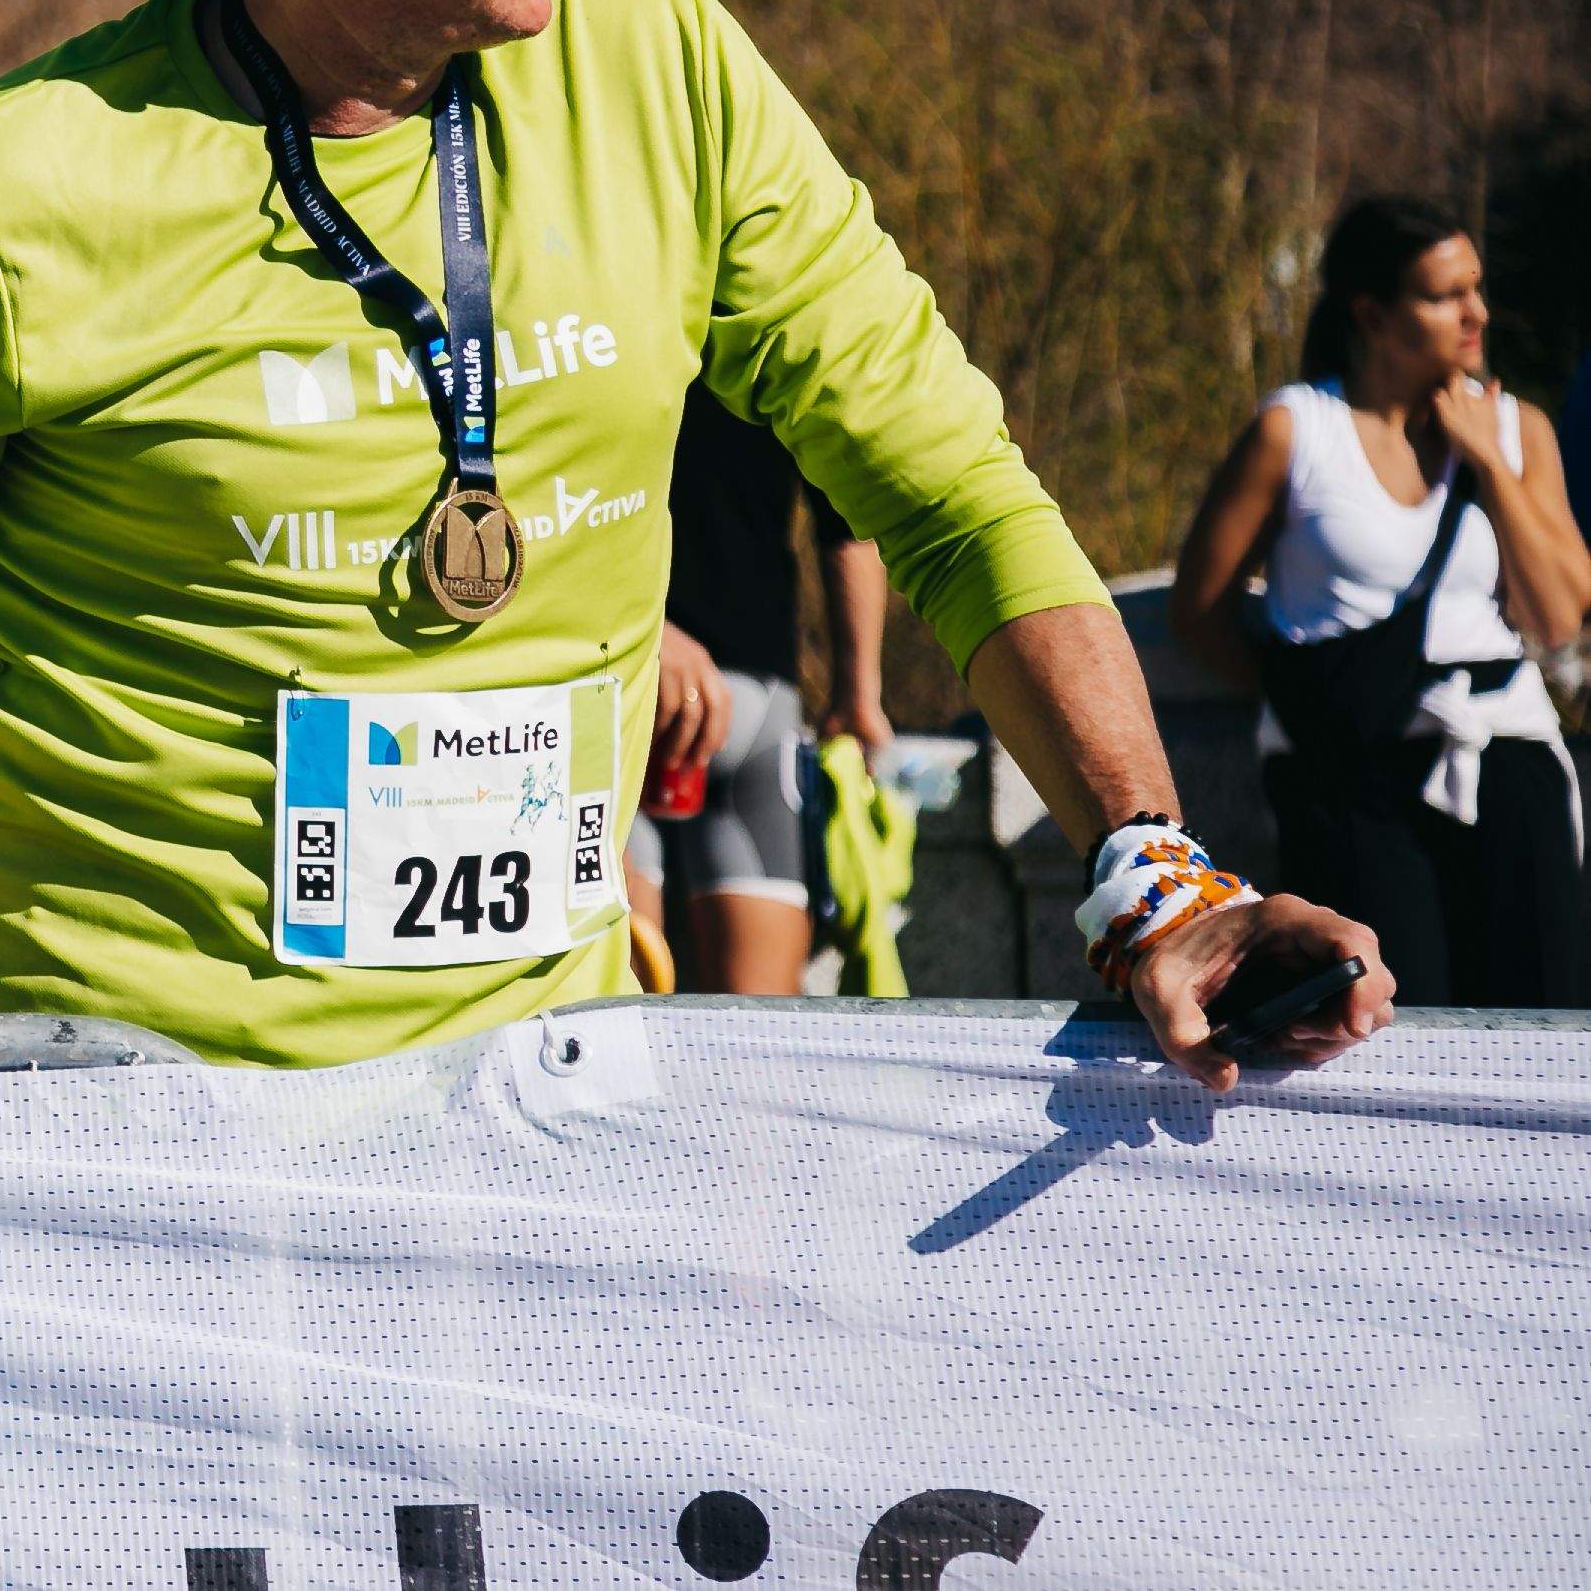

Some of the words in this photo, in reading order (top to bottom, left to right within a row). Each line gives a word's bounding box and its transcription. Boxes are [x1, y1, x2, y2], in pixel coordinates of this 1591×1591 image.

[450, 123, 464, 147] 15K
[449, 154, 469, 214] EDICIÓN
[297, 179, 337, 233] MADRID
[336, 235, 370, 277] ACTIVA
[457, 215, 472, 242] VIII
[375, 313, 619, 406] MLife
[462, 337, 483, 413] MetLife
[232, 510, 337, 570] VIII
[433, 722, 559, 758] MetLife
[369, 787, 403, 808] VIII
[436, 796, 476, 807] MADRID
[393, 851, 531, 939] 243
